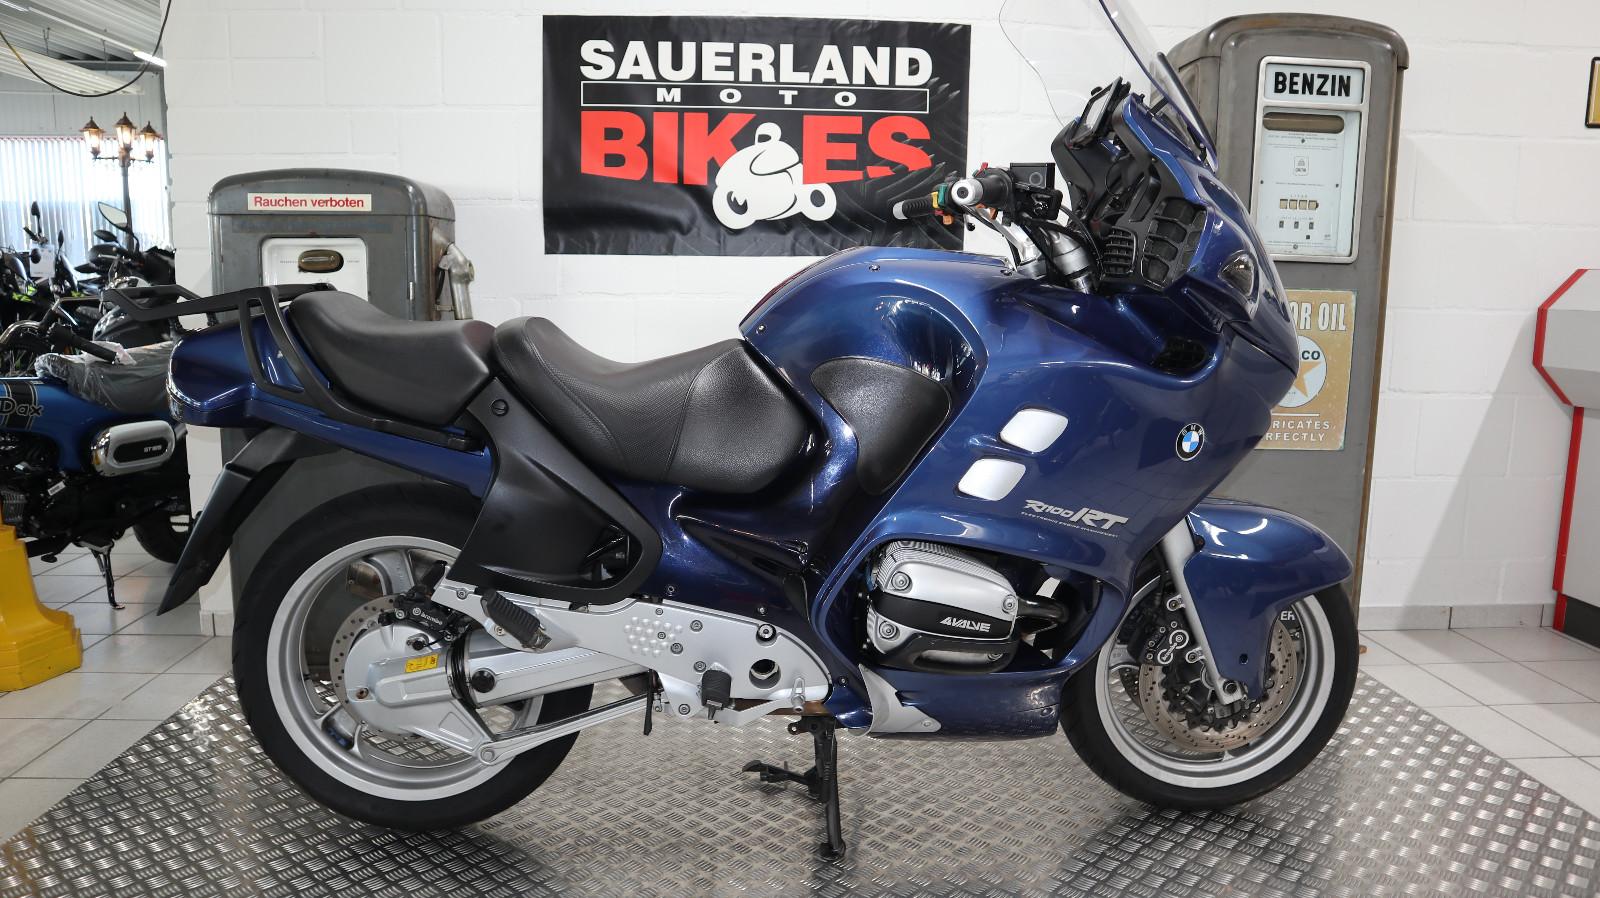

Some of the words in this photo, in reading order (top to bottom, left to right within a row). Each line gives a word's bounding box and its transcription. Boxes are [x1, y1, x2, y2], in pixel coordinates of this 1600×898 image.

[580, 39, 933, 86] SAUERLAND
[1274, 71, 1351, 97] BENZIN
[656, 87, 857, 107] MOTO
[254, 196, 307, 208] Rauchen
[311, 197, 364, 208] verboten
[1290, 302, 1312, 330] OR
[1318, 303, 1347, 331] OIL
[1301, 350, 1321, 361] CO
[1181, 424, 1204, 436] BMW
[1272, 420, 1330, 430] RICATES
[1265, 432, 1326, 442] RFECTLY
